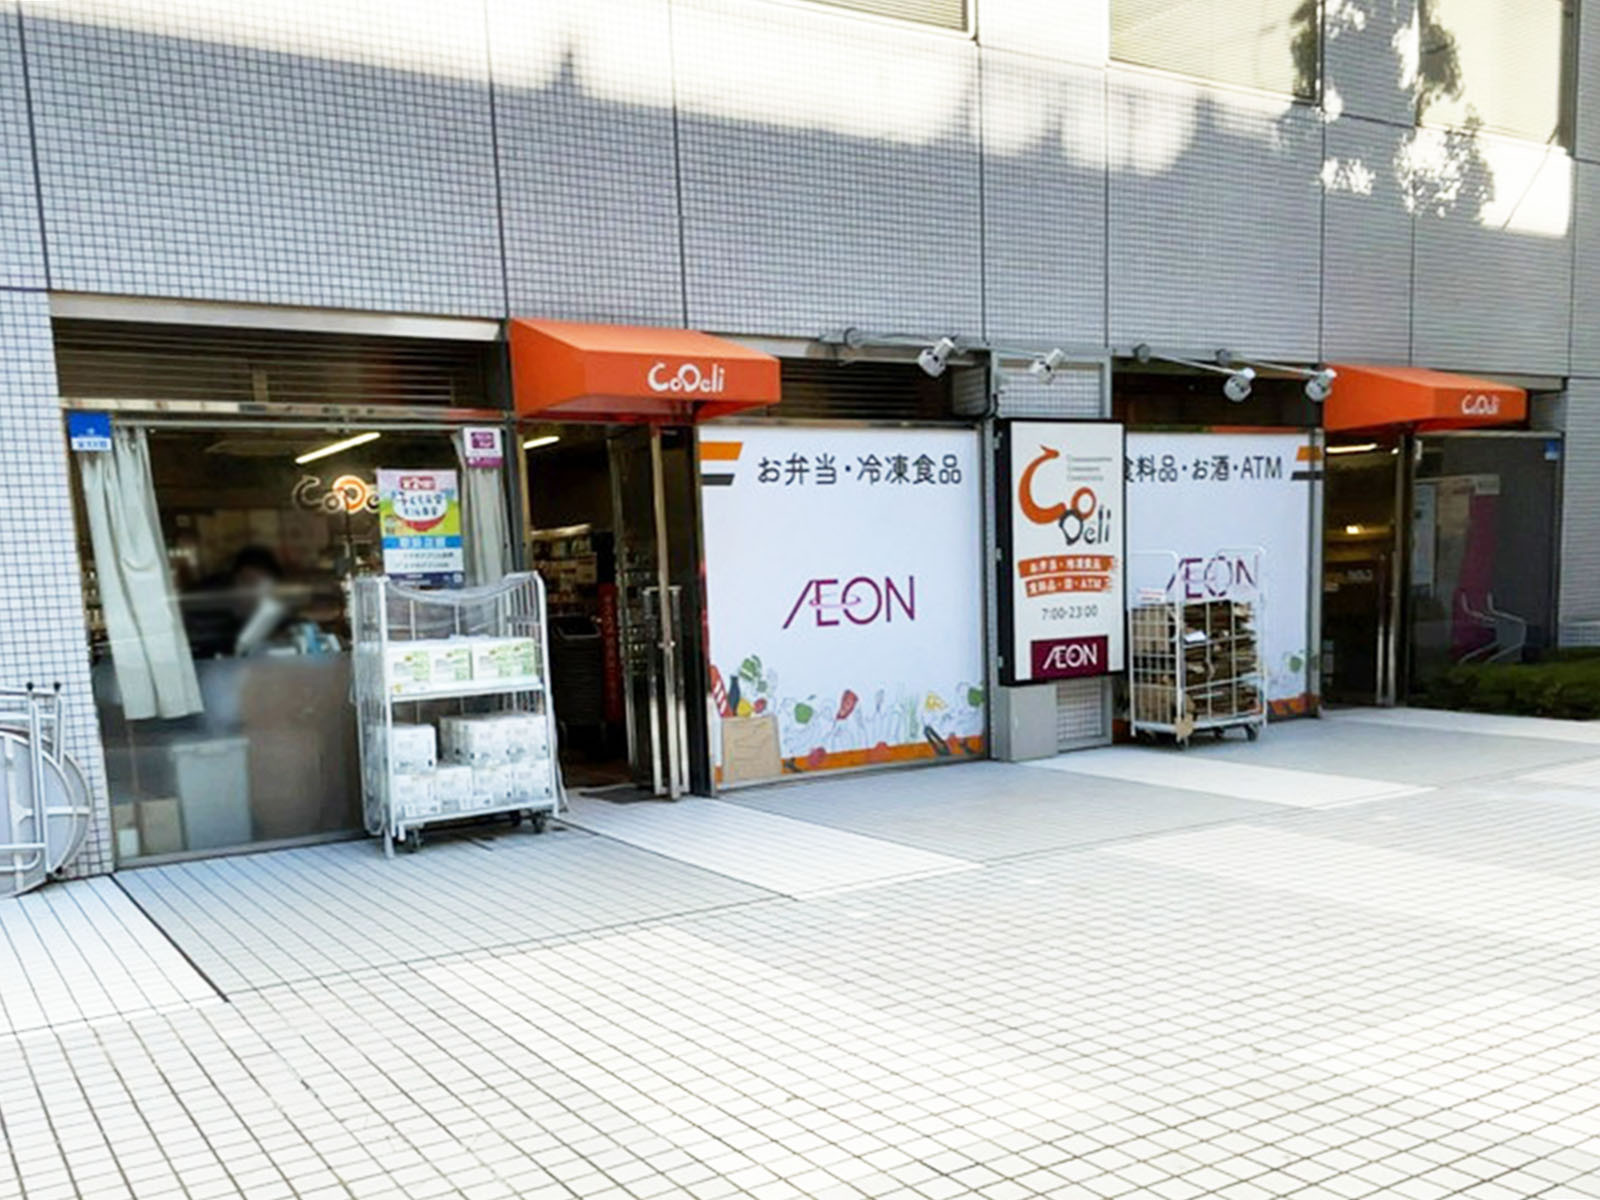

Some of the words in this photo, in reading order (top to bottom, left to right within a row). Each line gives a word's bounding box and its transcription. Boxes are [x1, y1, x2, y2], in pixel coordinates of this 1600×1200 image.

[647, 362, 725, 393] CoDeli
[757, 452, 962, 486] お弁当・冷凍食品
